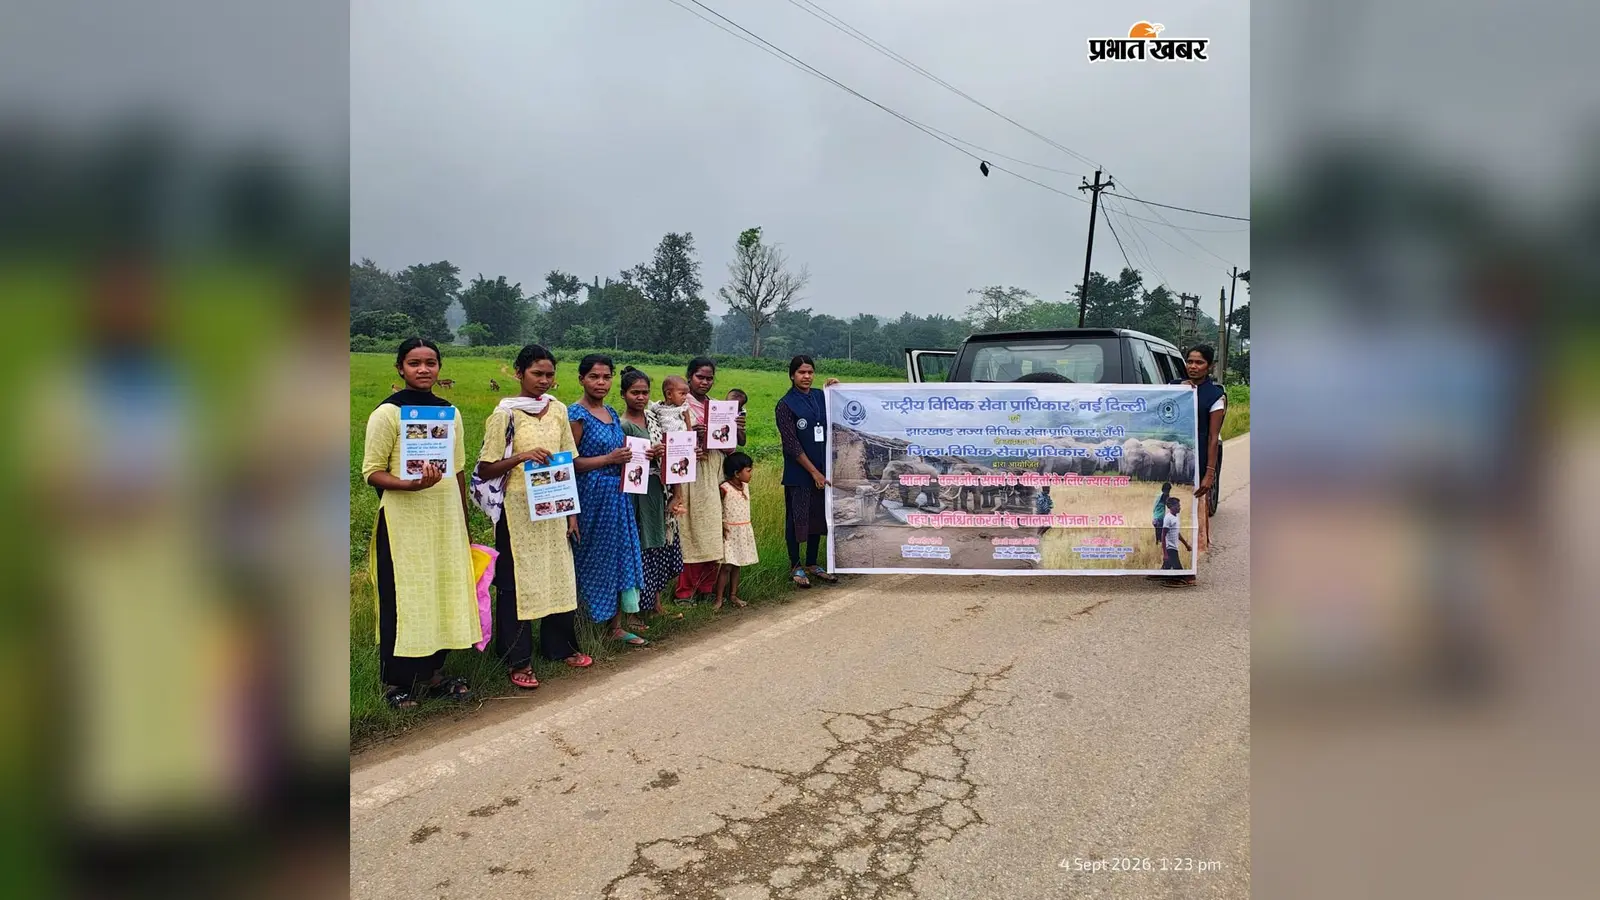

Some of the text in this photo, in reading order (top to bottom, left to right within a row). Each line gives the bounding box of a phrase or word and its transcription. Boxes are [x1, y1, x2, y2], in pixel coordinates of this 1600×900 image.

[881, 396, 1147, 414] राष्ट्रीय विधिक सेवा प्राधिकार, नई दिल्ली
[905, 427, 954, 437] झारखण्ड
[956, 427, 982, 436] राज्य
[985, 425, 1021, 436] विधिक
[1024, 426, 1047, 437] सेवा
[1049, 426, 1099, 438] प्राधिकार,
[907, 445, 1123, 462] जिला विधिक सेवा प्राधिकार, खूँटी
[899, 475, 930, 486] मानव
[938, 472, 979, 486] वन्यजीव
[981, 472, 1005, 486] संघर्ष
[1006, 472, 1018, 486] के
[1052, 472, 1063, 486] के
[1064, 473, 1083, 486] लिए
[1086, 475, 1111, 487] न्याय
[1113, 475, 1130, 487] तक
[930, 511, 974, 528] सुनिश्चित
[975, 512, 1002, 526] करने
[1003, 512, 1018, 528] हेतु
[1020, 514, 1054, 526] नालसा
[1056, 512, 1089, 526] योजना
[1098, 515, 1124, 526] 2025
